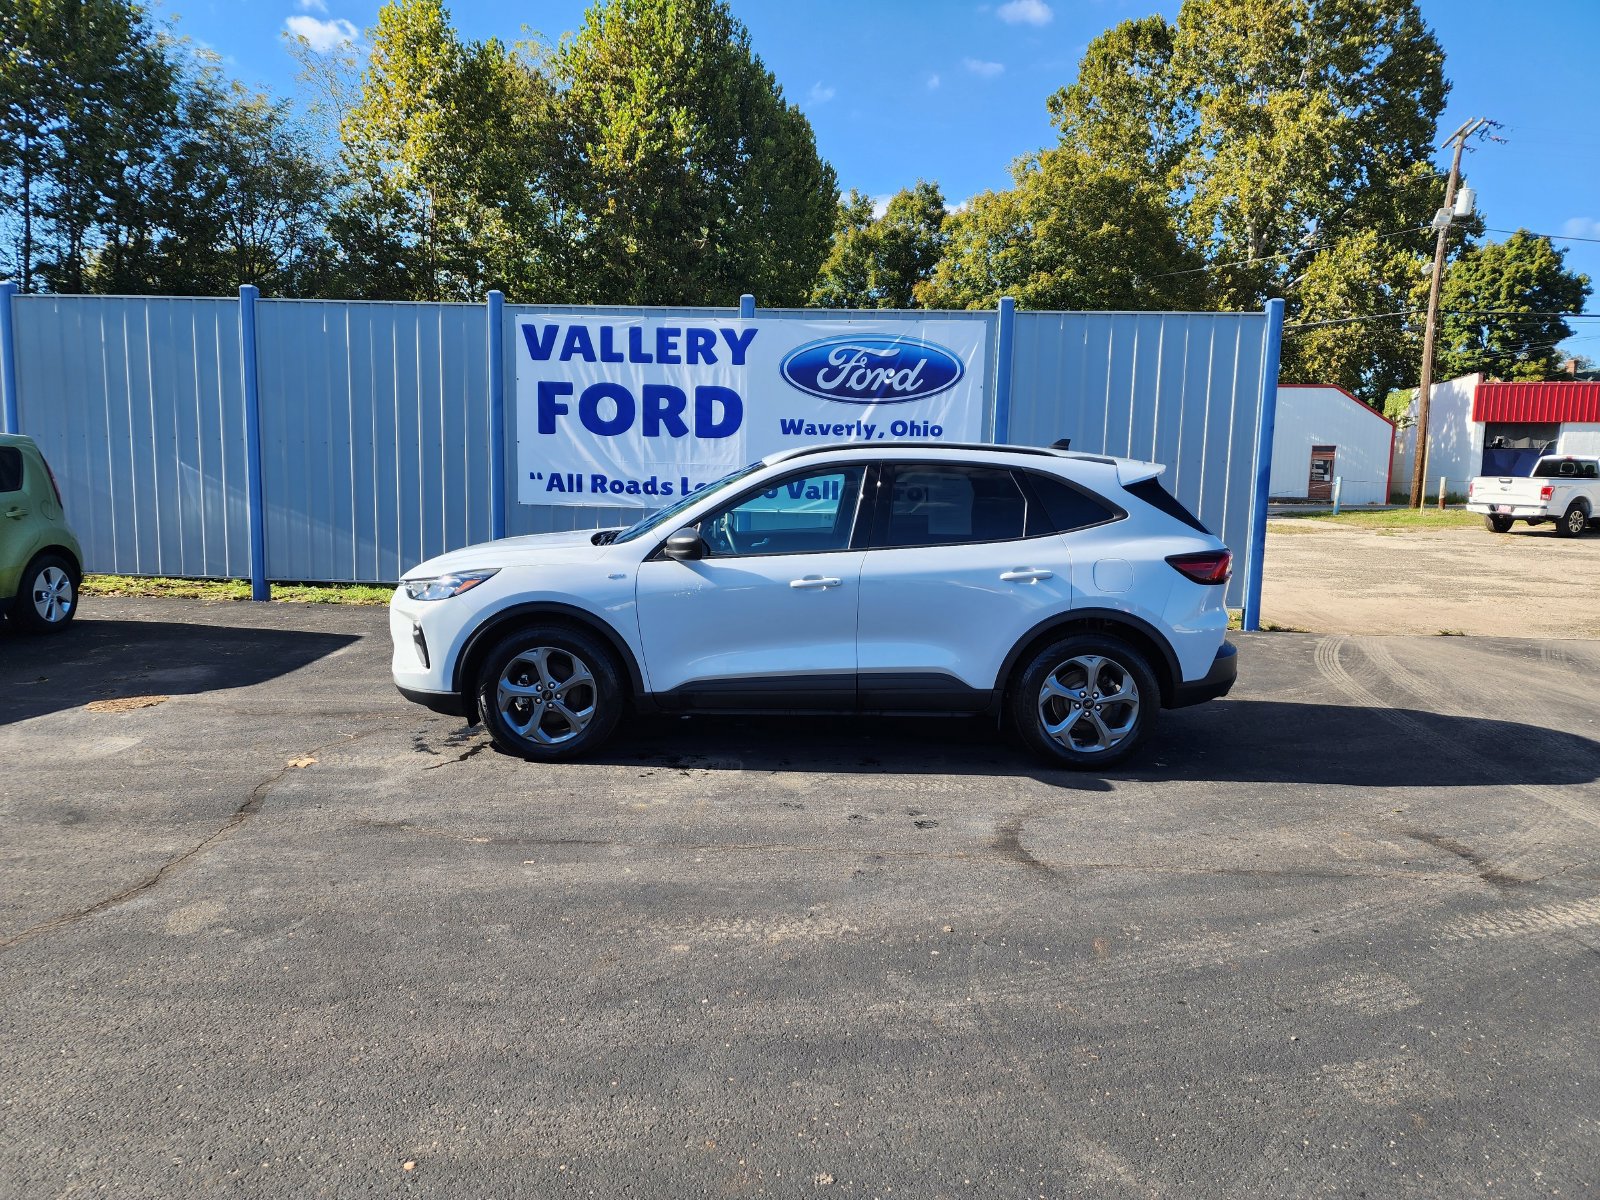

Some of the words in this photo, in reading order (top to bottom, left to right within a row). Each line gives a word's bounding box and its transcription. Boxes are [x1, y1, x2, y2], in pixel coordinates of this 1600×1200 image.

[521, 323, 759, 366] VALLERY
[816, 344, 928, 392] Ford
[537, 381, 744, 439] FORD
[780, 418, 885, 440] Waverly,
[890, 420, 943, 437] Ohio
[591, 475, 674, 496] Roads
